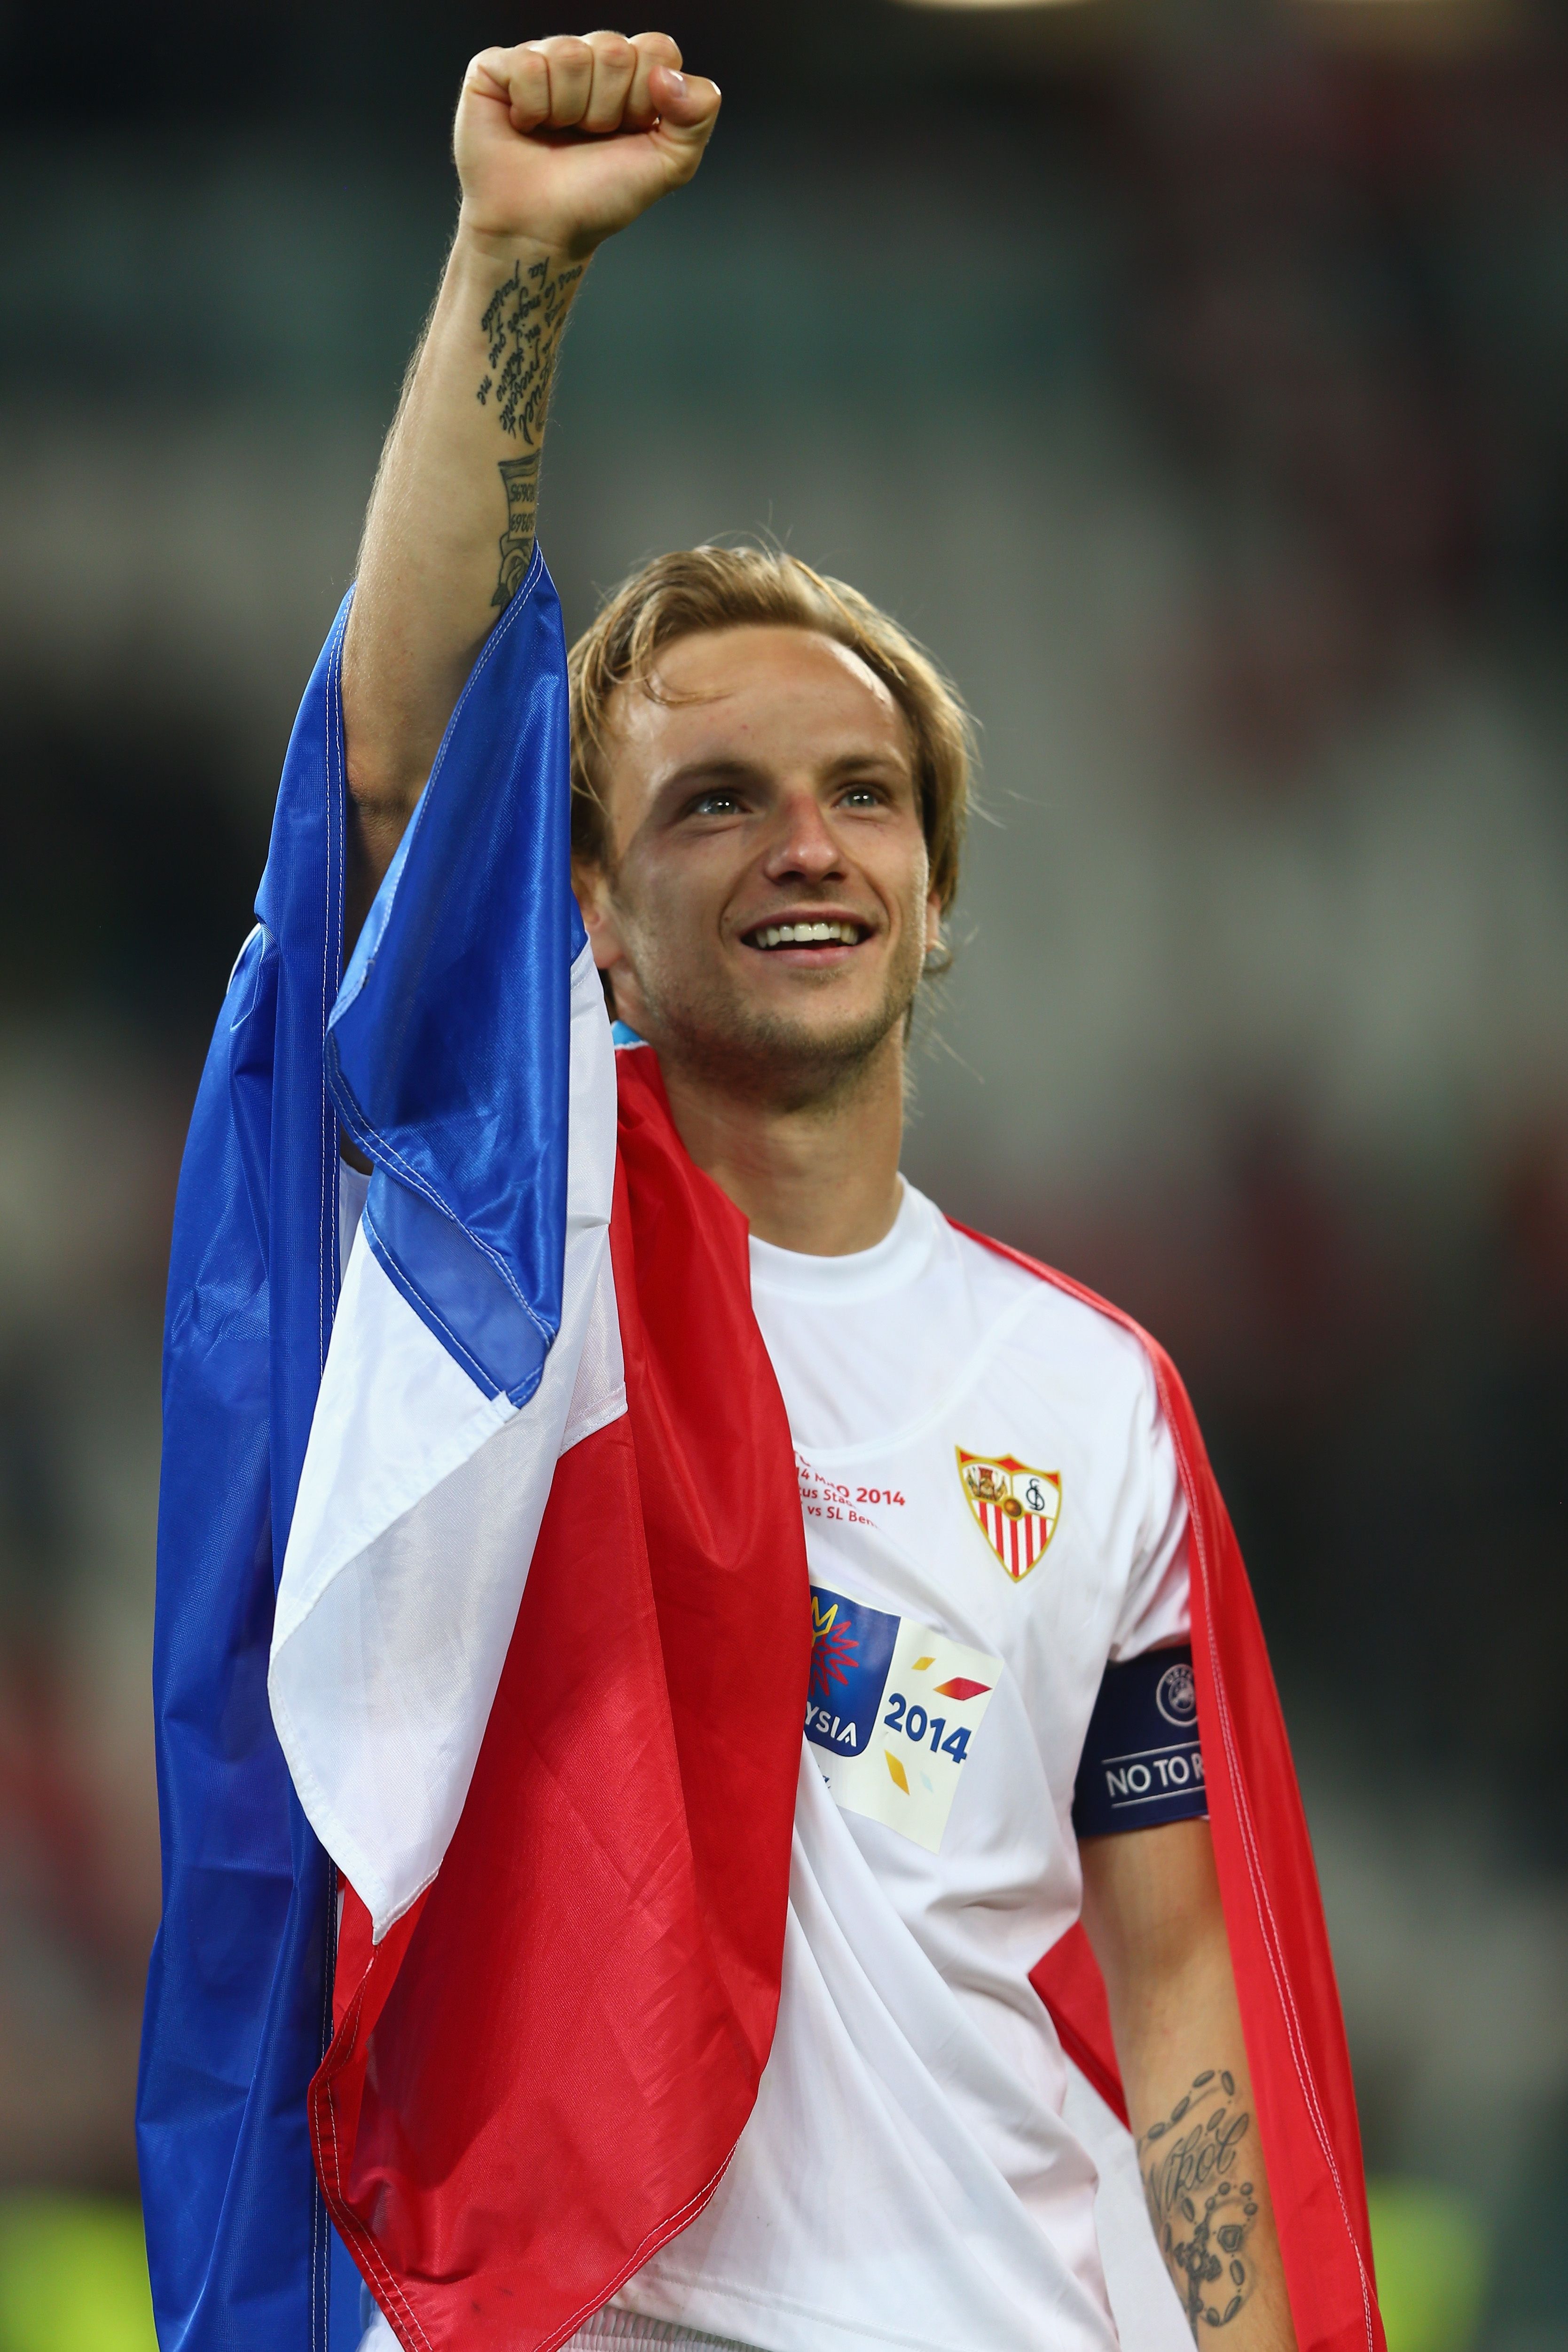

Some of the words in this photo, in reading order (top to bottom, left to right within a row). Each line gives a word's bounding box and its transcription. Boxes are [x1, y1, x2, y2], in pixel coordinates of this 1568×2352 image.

[856, 1487, 905, 1506] 2014
[808, 1505, 822, 1516] vs
[827, 1506, 843, 1520] SL
[884, 1693, 972, 1764] 2014
[1105, 1764, 1152, 1798] NO
[1153, 1756, 1190, 1787] TO
